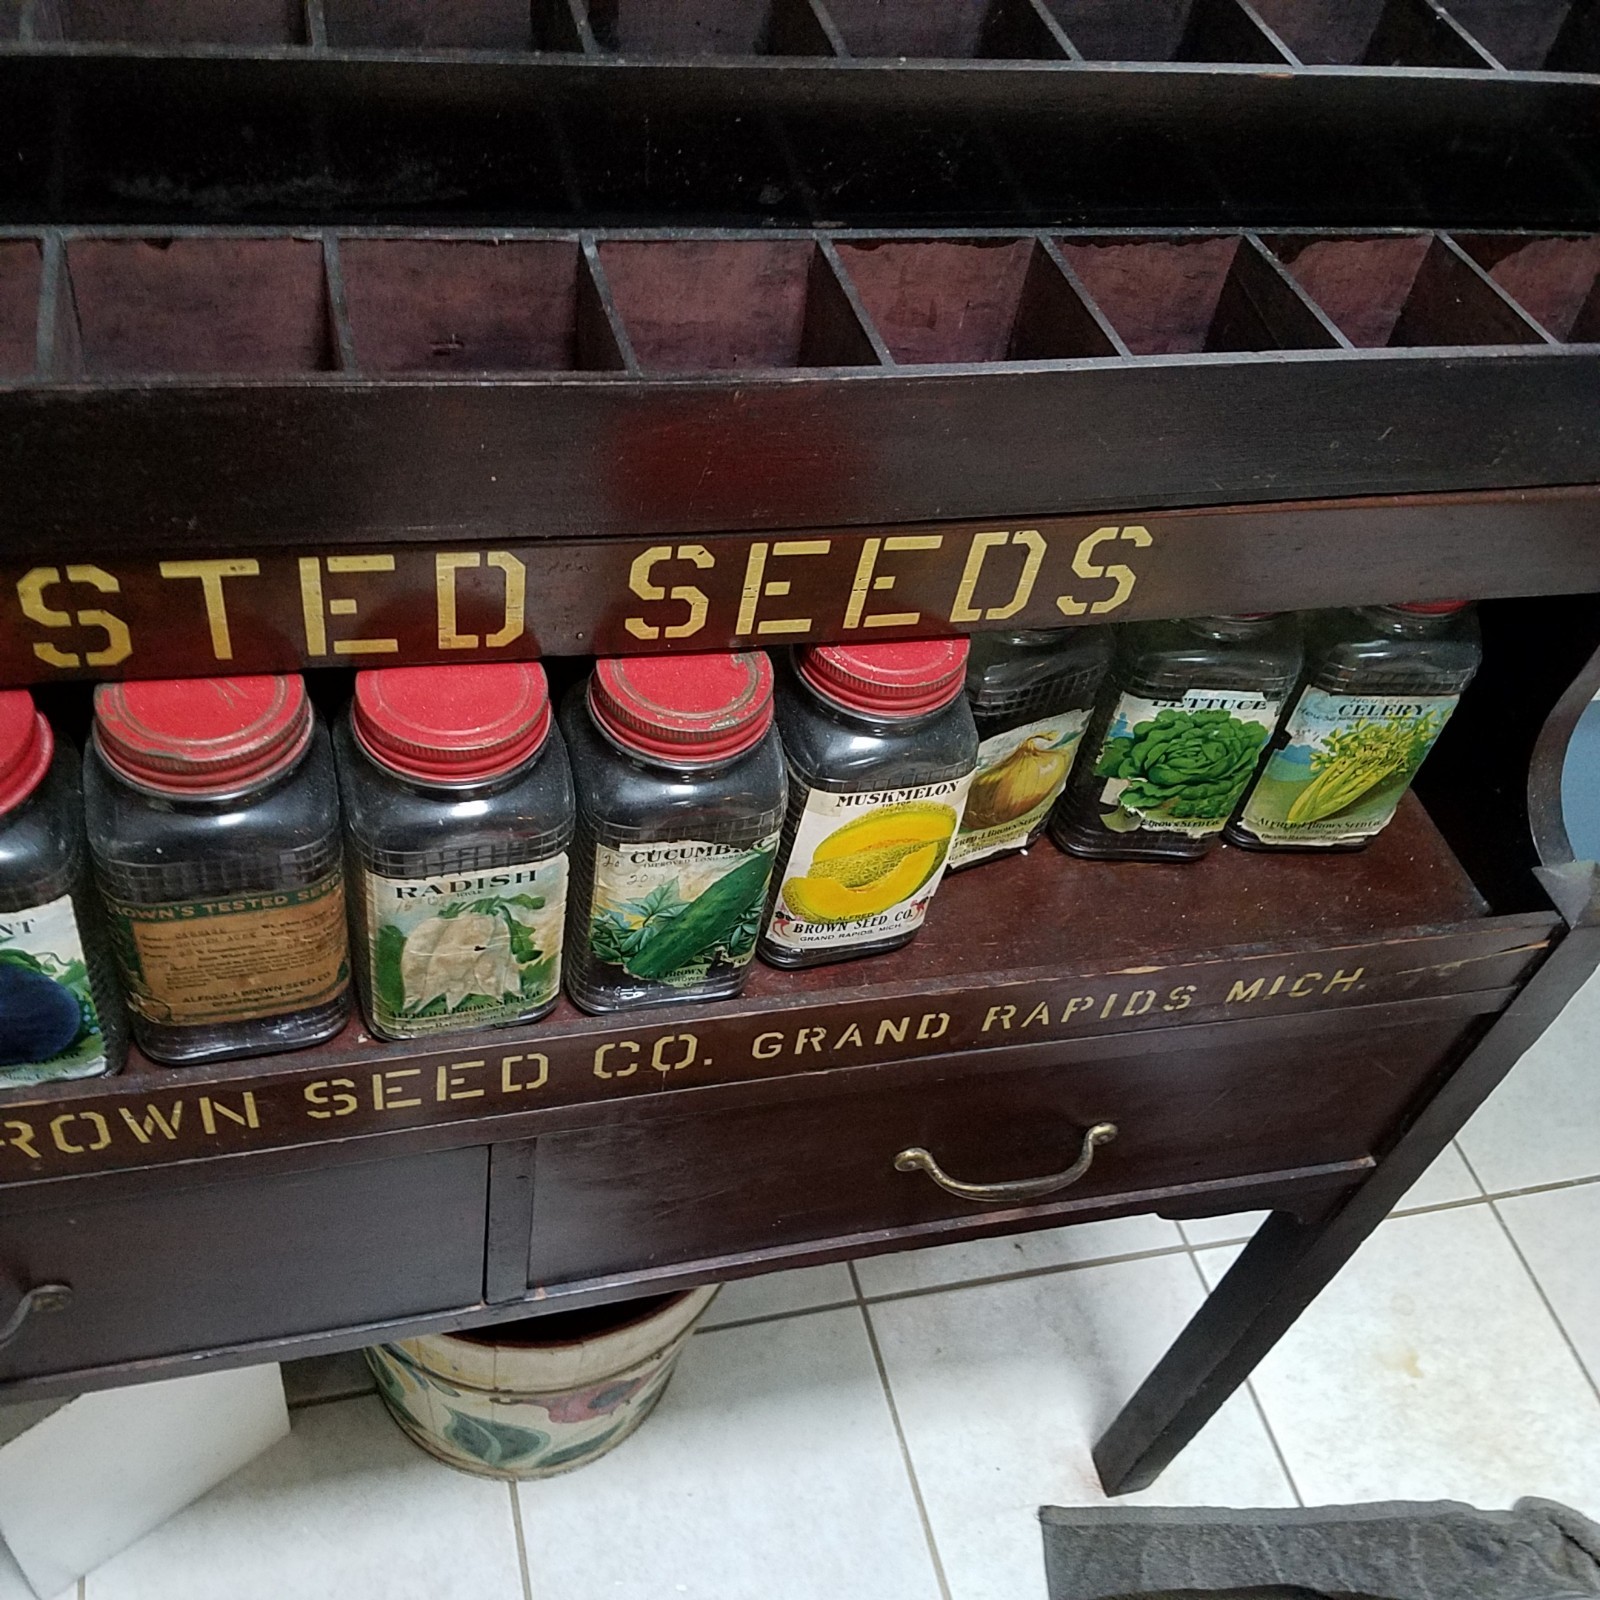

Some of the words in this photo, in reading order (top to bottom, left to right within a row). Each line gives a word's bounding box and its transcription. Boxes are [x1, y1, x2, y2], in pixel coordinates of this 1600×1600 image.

[625, 526, 1154, 640] SEEDS
[1152, 698, 1267, 710] LETTUCE
[1339, 704, 1428, 716] CELERY
[835, 781, 959, 808] MUSKMELON
[396, 870, 537, 899] RADISH
[201, 896, 288, 914] TESTED
[793, 920, 848, 934] BROWN
[854, 915, 888, 930] SEED
[895, 909, 914, 922] CO.
[837, 912, 875, 922] ALFRED
[800, 934, 835, 942] GRAND
[304, 1053, 549, 1119] SEED
[593, 1033, 712, 1079] CO.
[752, 1012, 951, 1059] GRAND
[981, 985, 1197, 1032] RAPIDS
